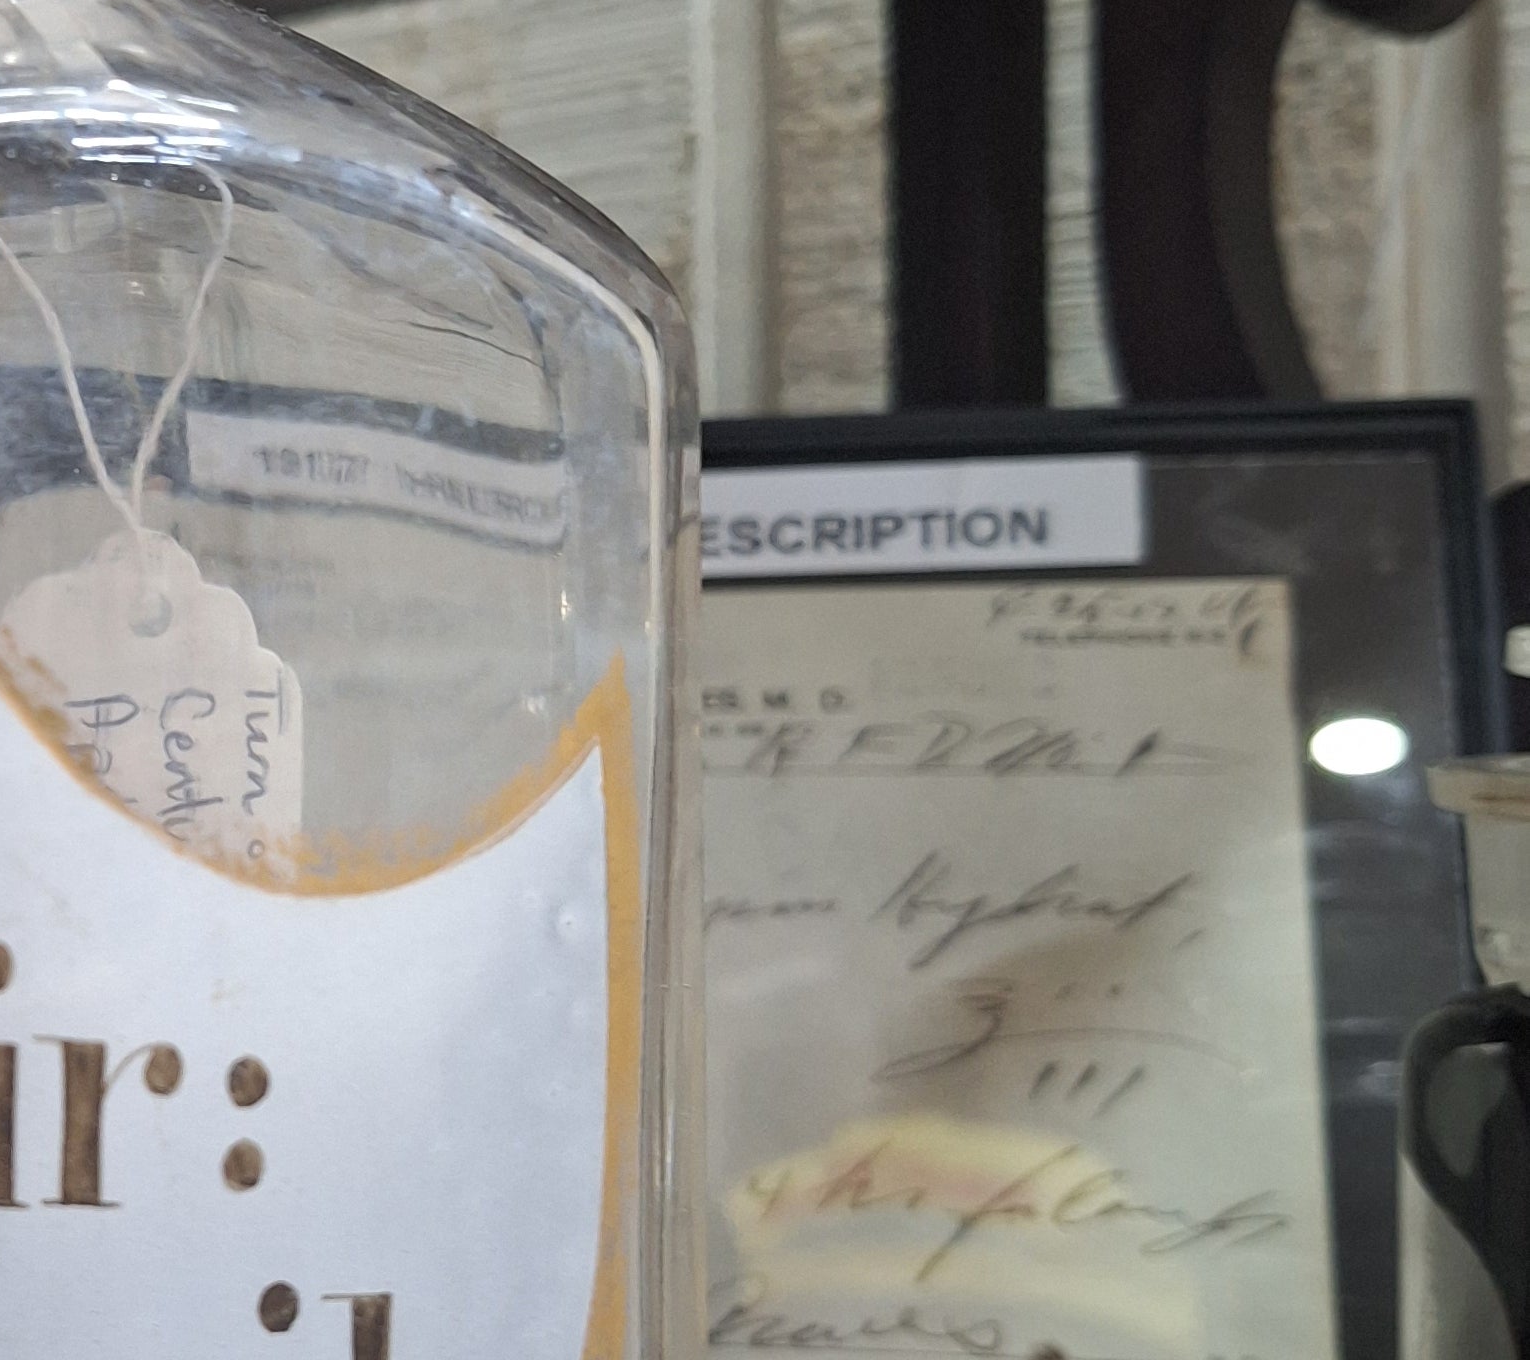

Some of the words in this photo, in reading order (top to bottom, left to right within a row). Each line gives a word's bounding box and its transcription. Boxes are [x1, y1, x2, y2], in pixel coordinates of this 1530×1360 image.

[701, 506, 1048, 556] ESCRIPTION
[156, 687, 224, 843] Centu
[246, 838, 267, 861] o
